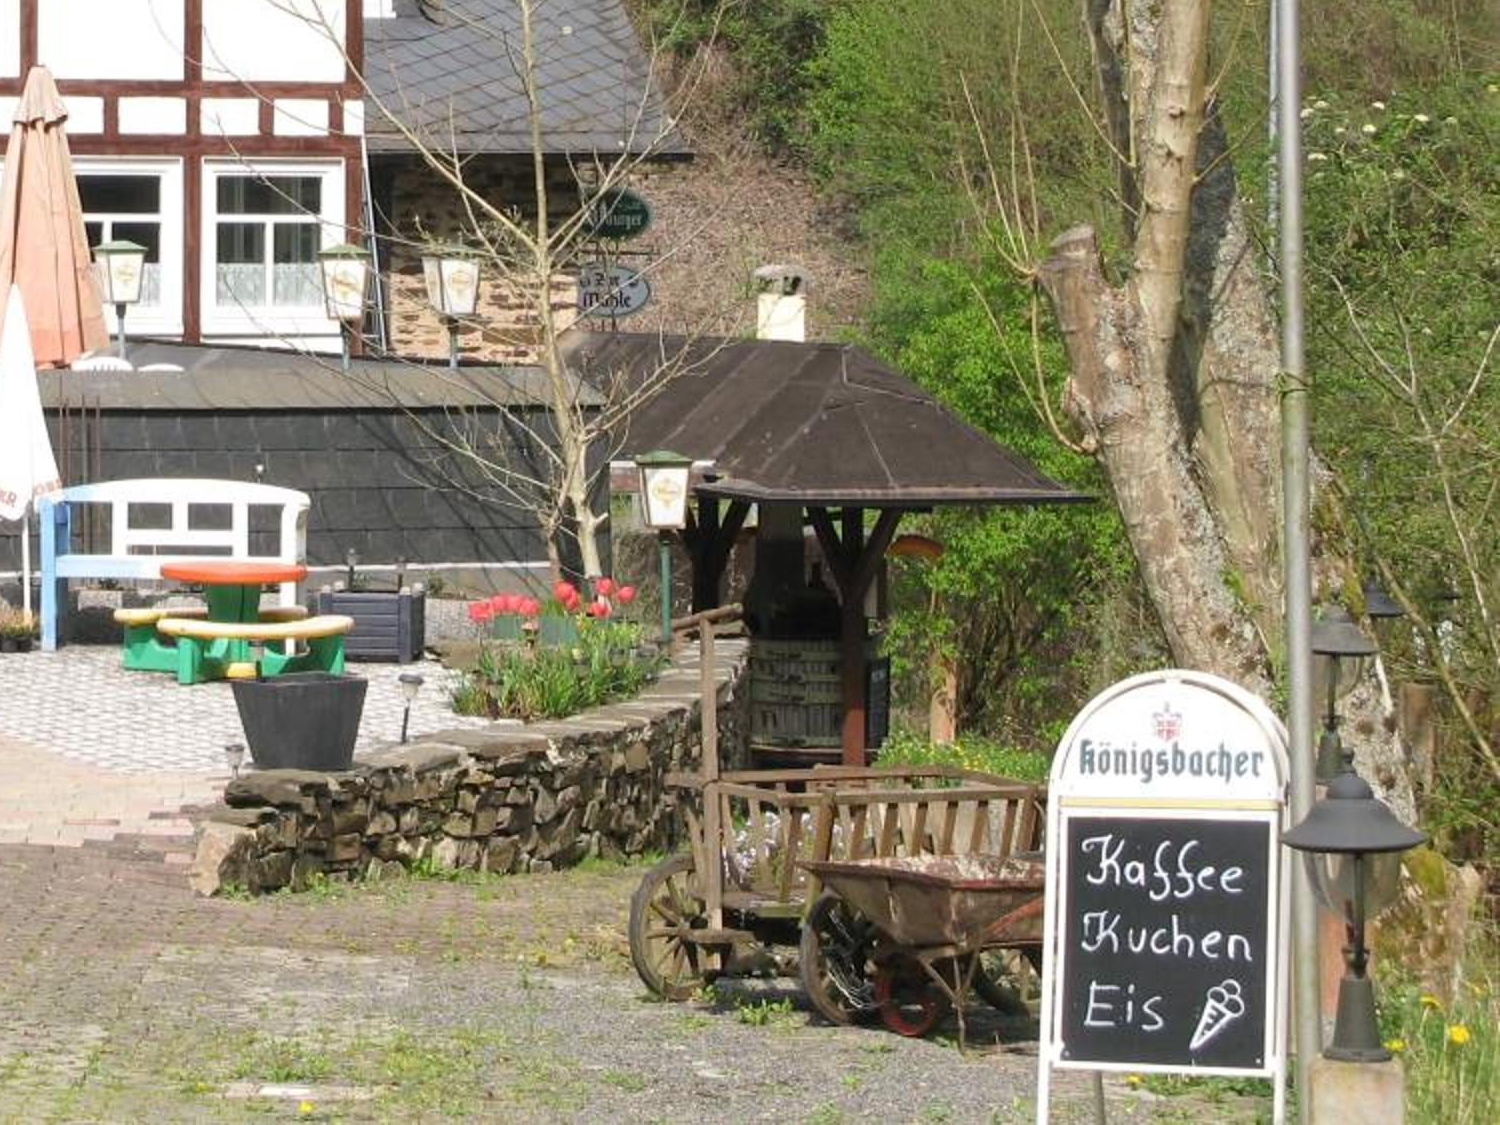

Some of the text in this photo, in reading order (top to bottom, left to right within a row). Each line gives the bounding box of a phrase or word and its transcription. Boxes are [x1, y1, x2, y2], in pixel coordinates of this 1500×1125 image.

[1079, 738, 1264, 783] Königsbacher
[1081, 834, 1244, 901] Kaffee
[1081, 909, 1253, 962] Kuchen
[1083, 979, 1164, 1032] Eis
